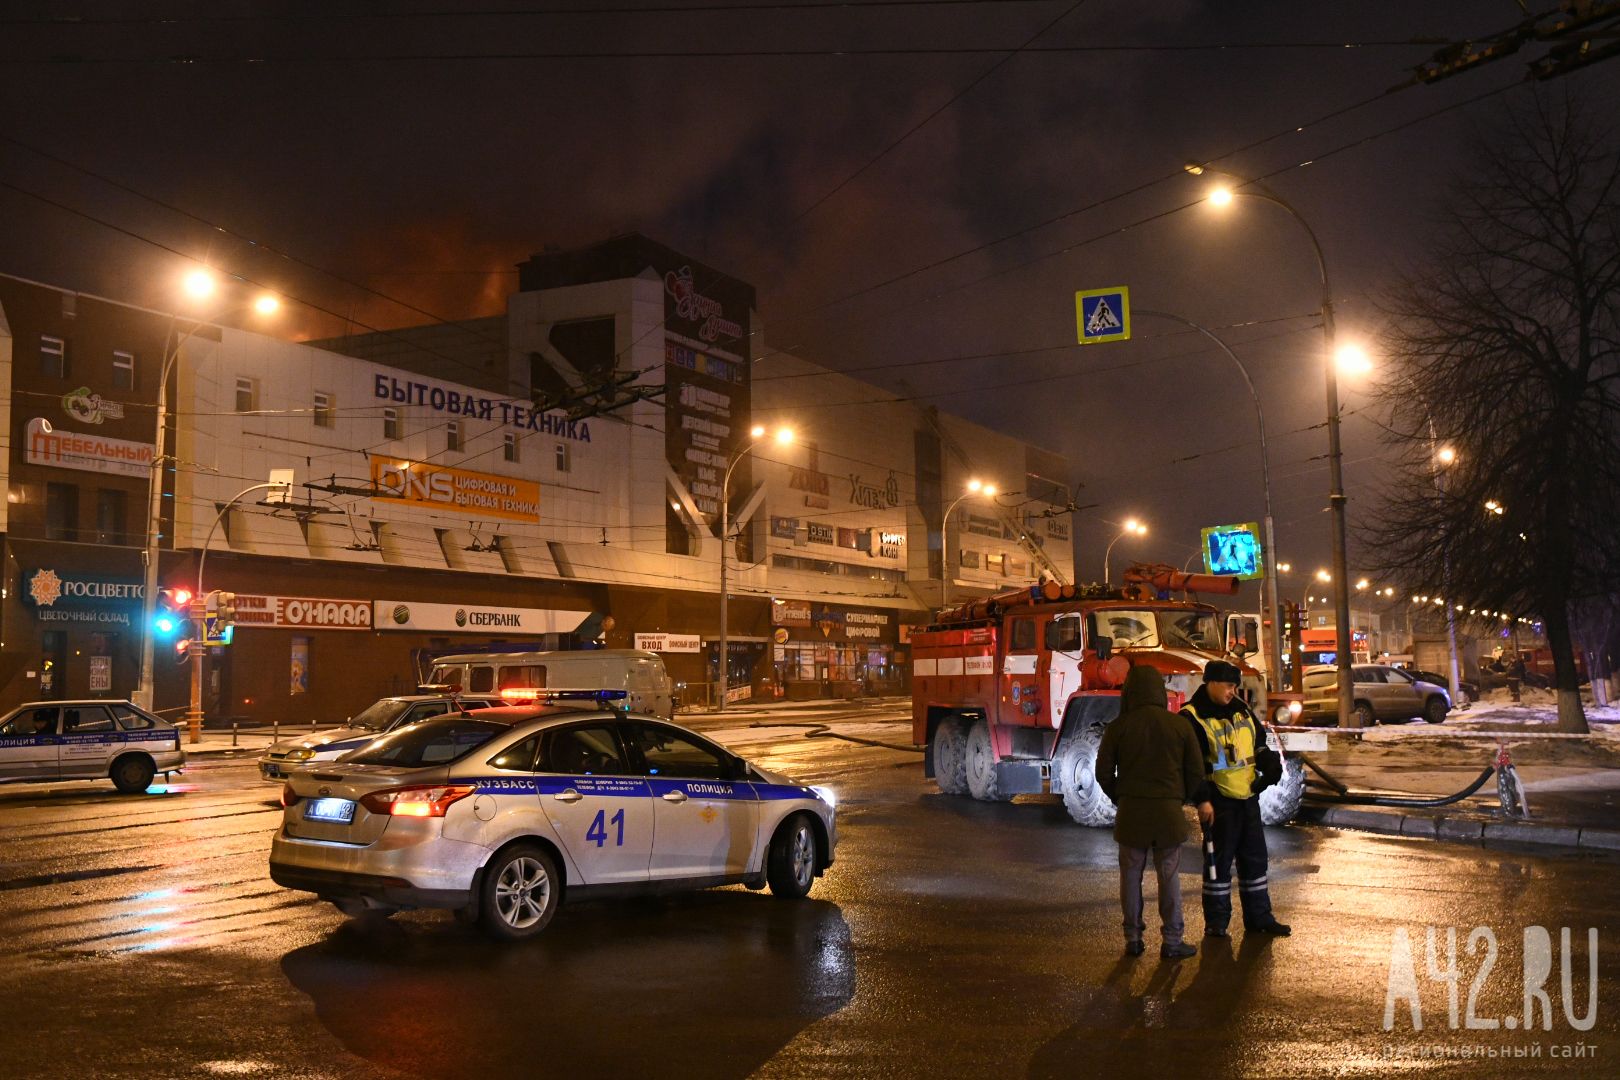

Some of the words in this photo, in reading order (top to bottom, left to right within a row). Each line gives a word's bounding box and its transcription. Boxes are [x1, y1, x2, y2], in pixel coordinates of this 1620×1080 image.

[374, 373, 494, 421] БЫТОВАЯ
[499, 402, 592, 443] ТЕХНИКА
[32, 430, 152, 463] МЕБЕЛЬНЫЙ
[380, 462, 455, 503] DNS
[455, 475, 507, 496] ЦИФРОВАЯ
[509, 484, 517, 496] И
[455, 493, 499, 510] БЫТОВАЯ
[501, 500, 540, 517] ТЕХНИКА
[64, 581, 168, 599] РОСЦВЕТТОГ
[39, 610, 97, 622] ЦВЕТОЧНЫЙ
[98, 613, 130, 625] СКЛАД
[285, 601, 371, 626] O'HARA
[469, 611, 521, 627] СБЕРБАНК
[846, 612, 888, 625] СУПЕРМАРКЕТ
[846, 626, 880, 638] ЦИФРОВОЙ
[641, 641, 662, 650] ВХОД
[475, 779, 535, 790] КУЗБАСС
[687, 783, 734, 795] ПОЛИЦИЯ
[585, 808, 625, 848] 41
